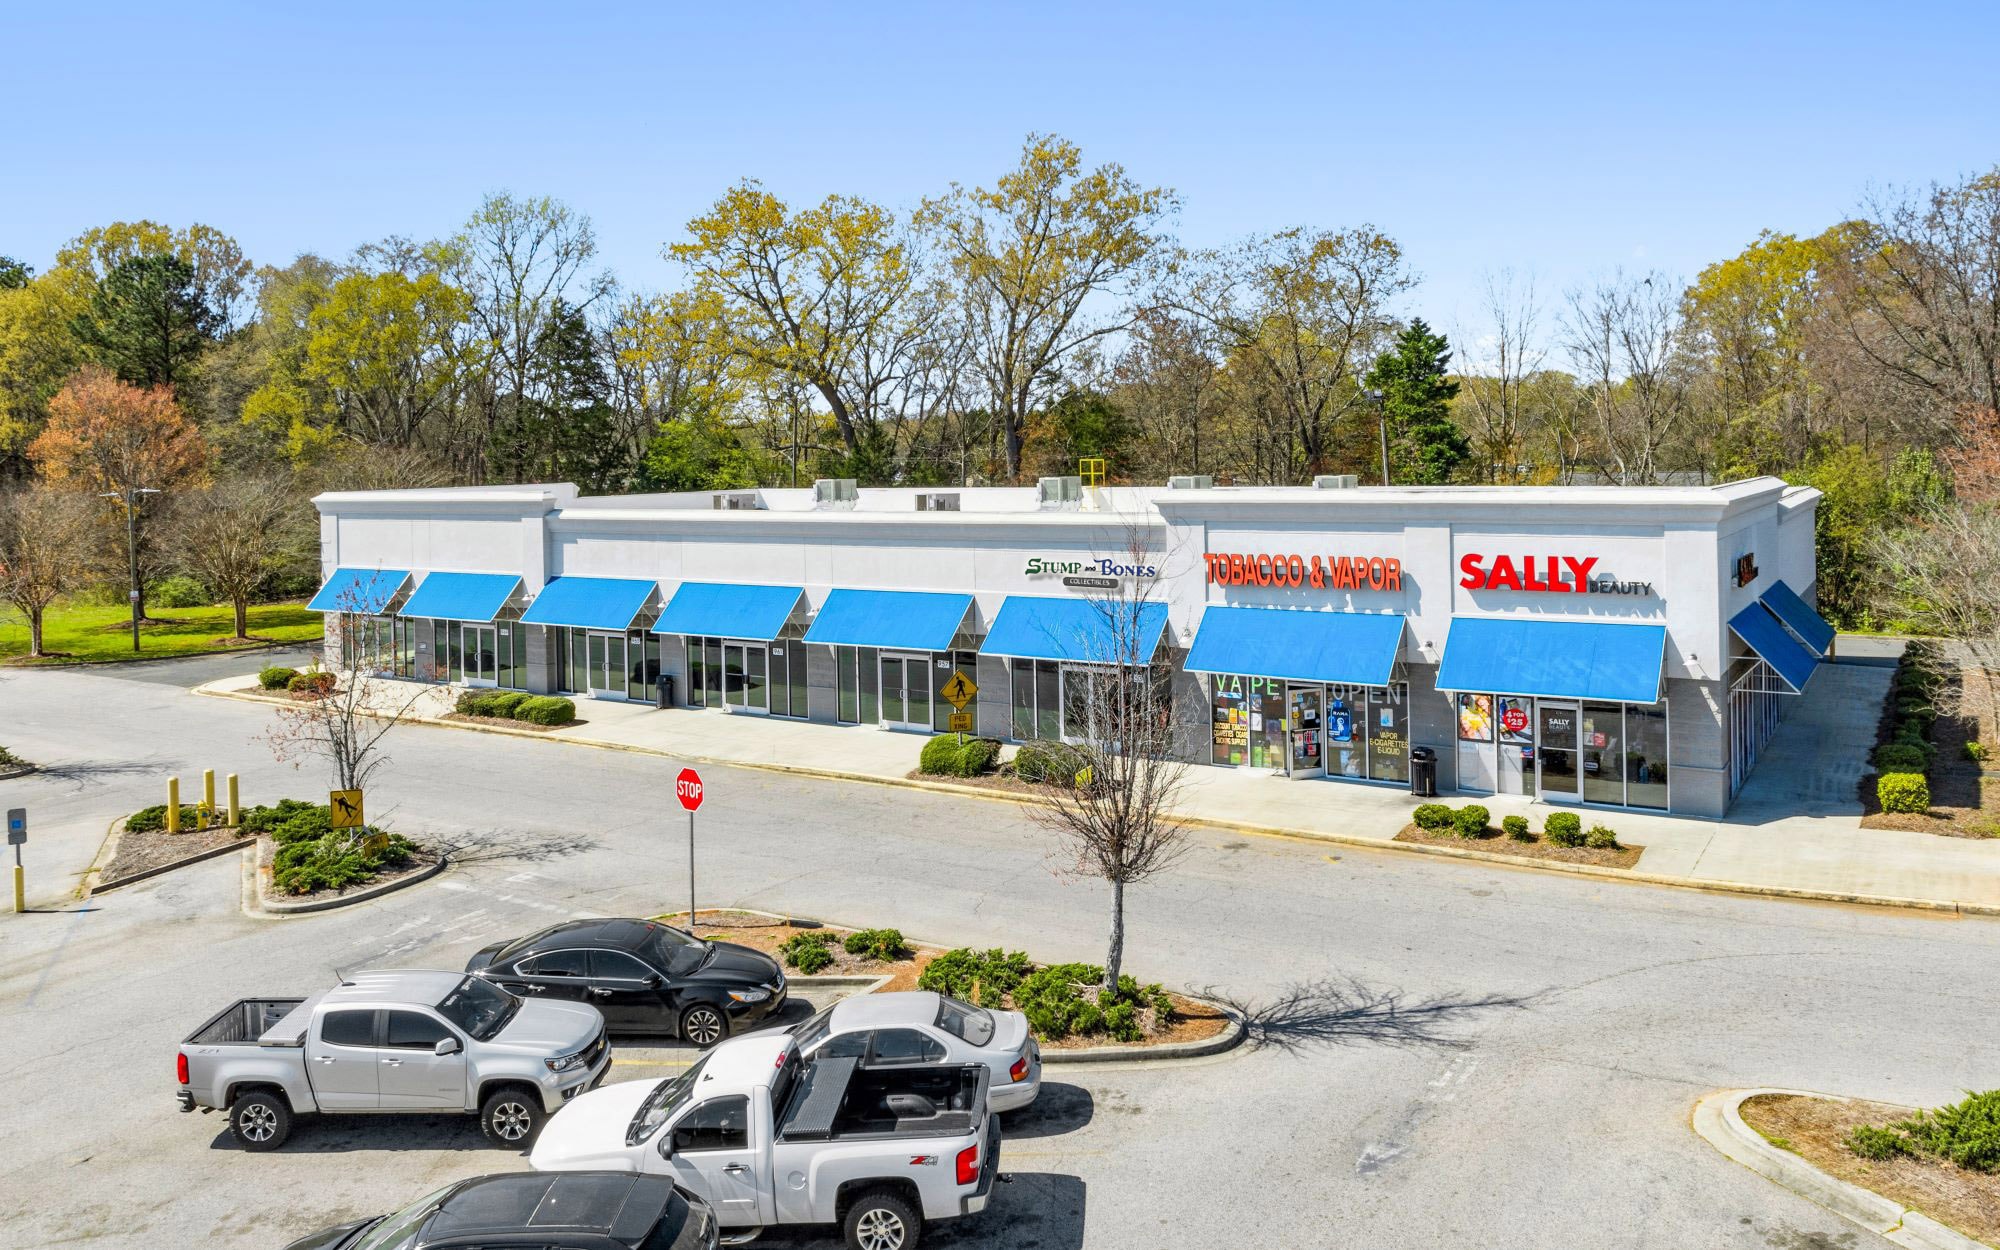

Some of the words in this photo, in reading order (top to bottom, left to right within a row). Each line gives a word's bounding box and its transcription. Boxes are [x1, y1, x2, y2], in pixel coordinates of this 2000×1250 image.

[1025, 558, 1082, 576] STUMP
[1094, 558, 1156, 578] BONES
[1203, 553, 1304, 588] TOBACCO
[1309, 555, 1326, 590] &
[1328, 556, 1401, 592] VAPOR
[1459, 553, 1599, 593] SALLY
[1589, 580, 1652, 596] BEAUTY
[1069, 578, 1110, 586] COLLECTIBLES
[1215, 673, 1279, 696] VAPE
[1332, 684, 1401, 705] OPEN
[1507, 718, 1523, 726] $25
[1369, 737, 1409, 749] E-CIGARETTES
[1379, 731, 1398, 740] VAPOR
[1377, 746, 1401, 756] E-LIQUID
[677, 779, 702, 800] STOP
